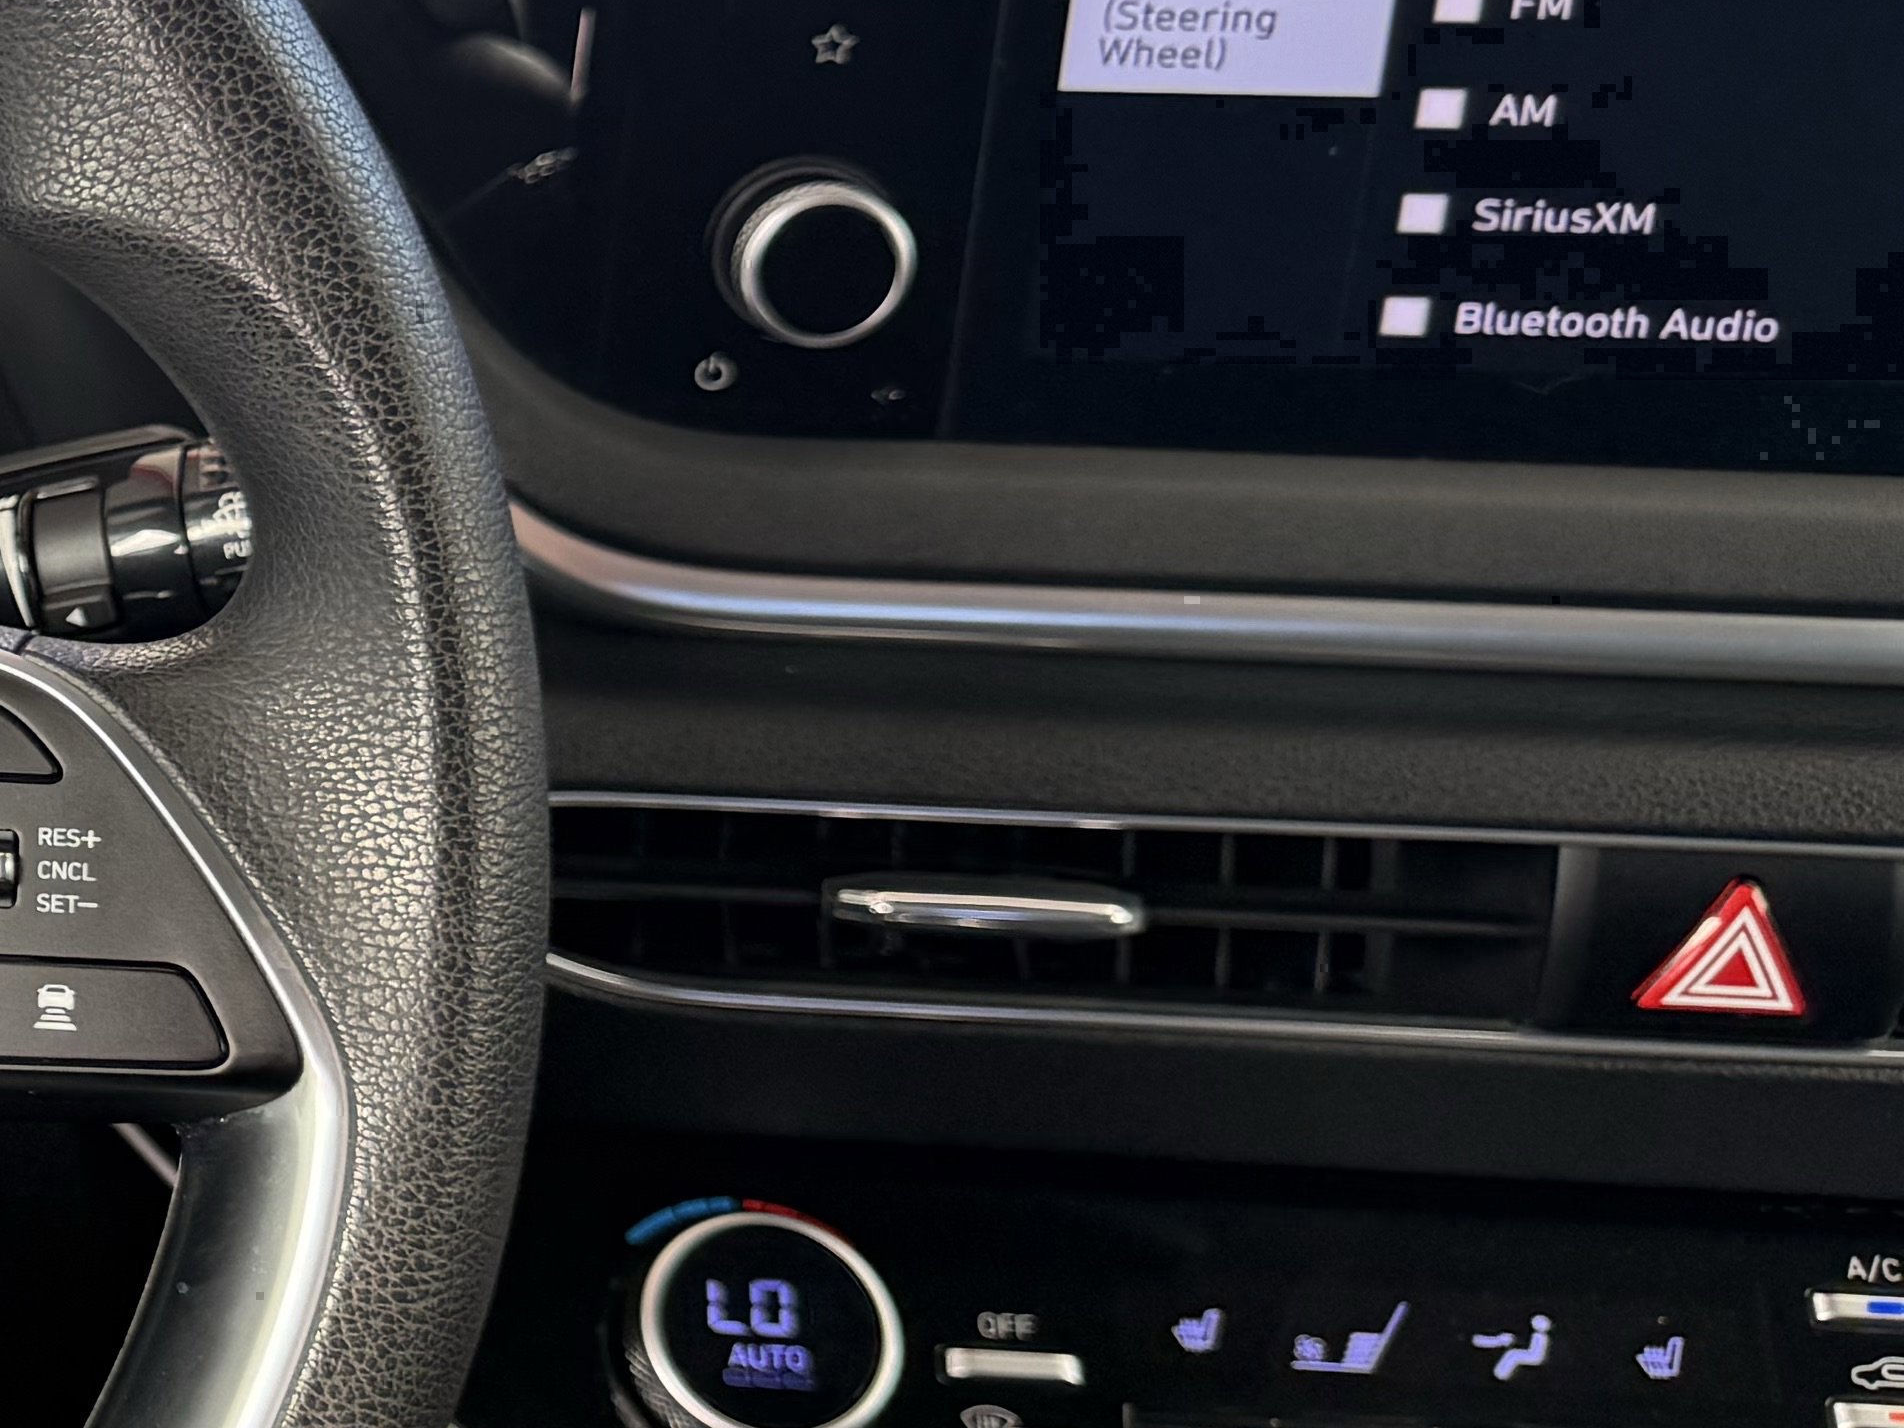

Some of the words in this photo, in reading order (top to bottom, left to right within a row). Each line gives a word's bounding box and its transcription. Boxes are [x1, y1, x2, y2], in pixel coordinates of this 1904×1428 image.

[1099, 38, 1227, 71] Wheel)
[1488, 93, 1558, 128] AM
[1471, 197, 1657, 236] SiriusXM
[1454, 301, 1650, 340] Bluetooth
[1658, 308, 1780, 345] Audio
[37, 860, 97, 883] CNCL
[1847, 1254, 1904, 1283] A/C
[977, 1311, 1038, 1341] OFF
[728, 1342, 813, 1374] AUTO
